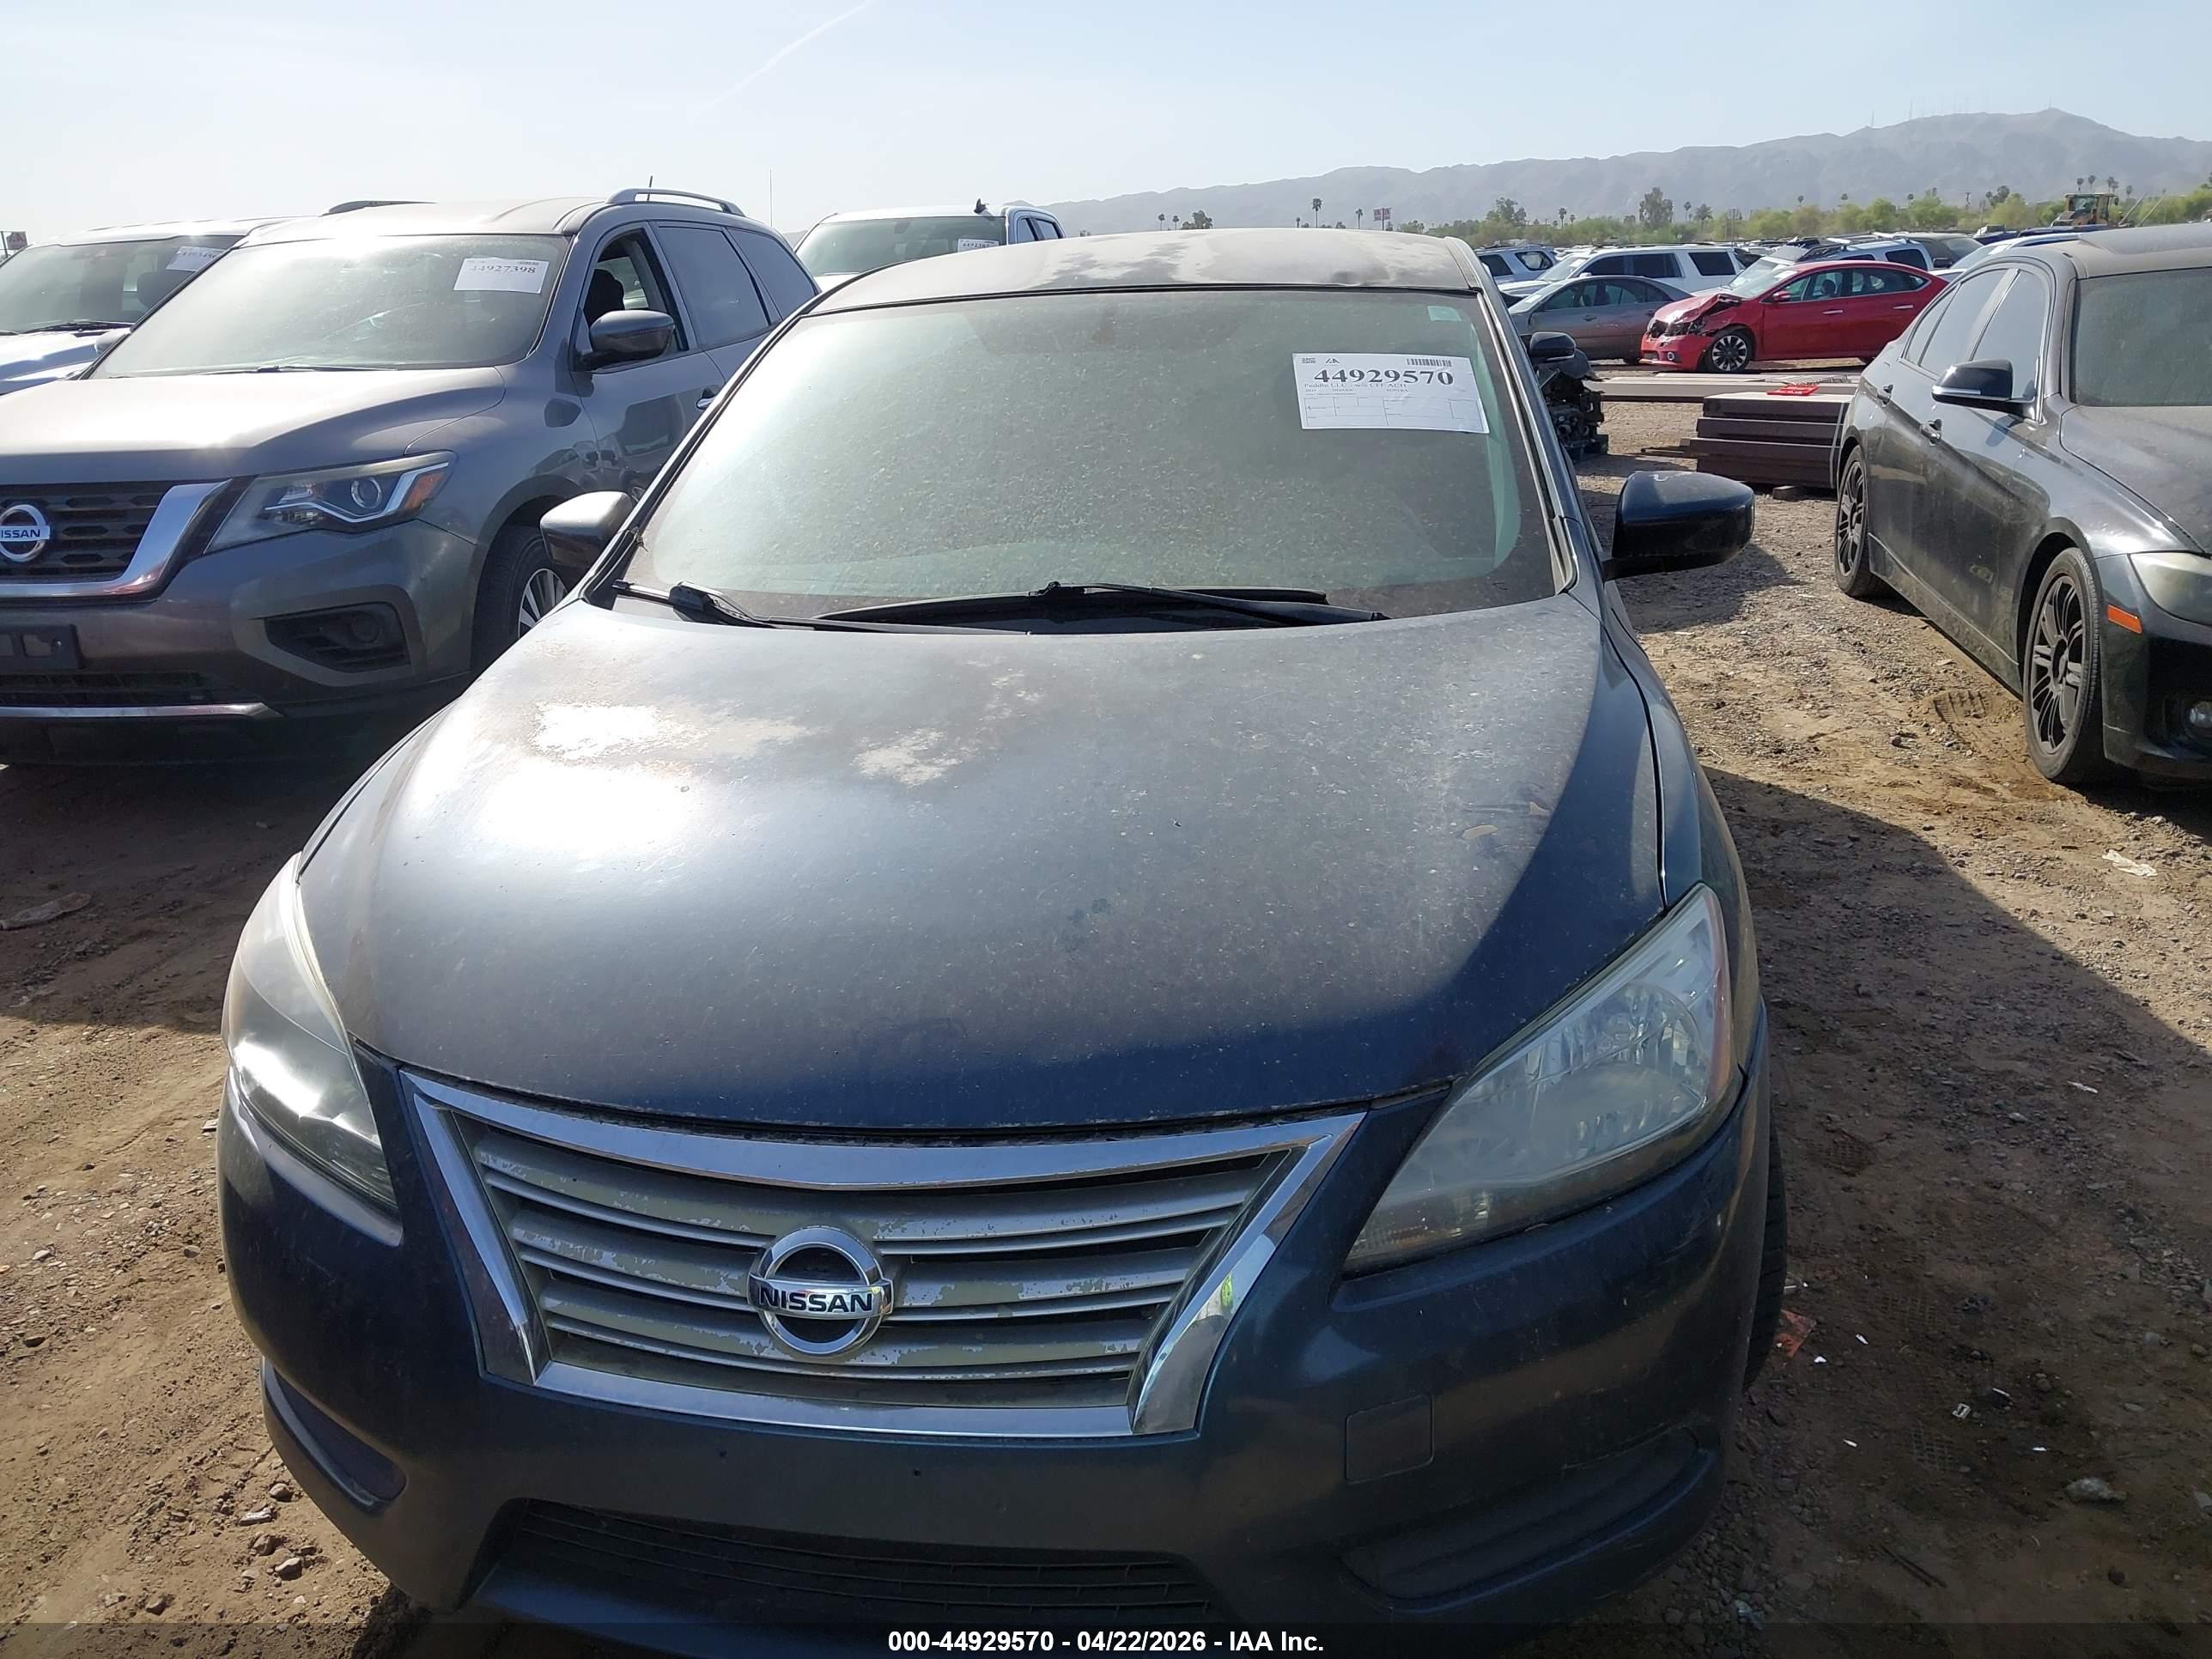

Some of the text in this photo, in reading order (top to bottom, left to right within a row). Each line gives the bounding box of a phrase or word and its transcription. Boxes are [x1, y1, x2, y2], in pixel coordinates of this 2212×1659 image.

[1314, 368, 1454, 386] 44929570
[0, 528, 40, 538] ISSAN
[759, 1285, 872, 1313] NISSAN
